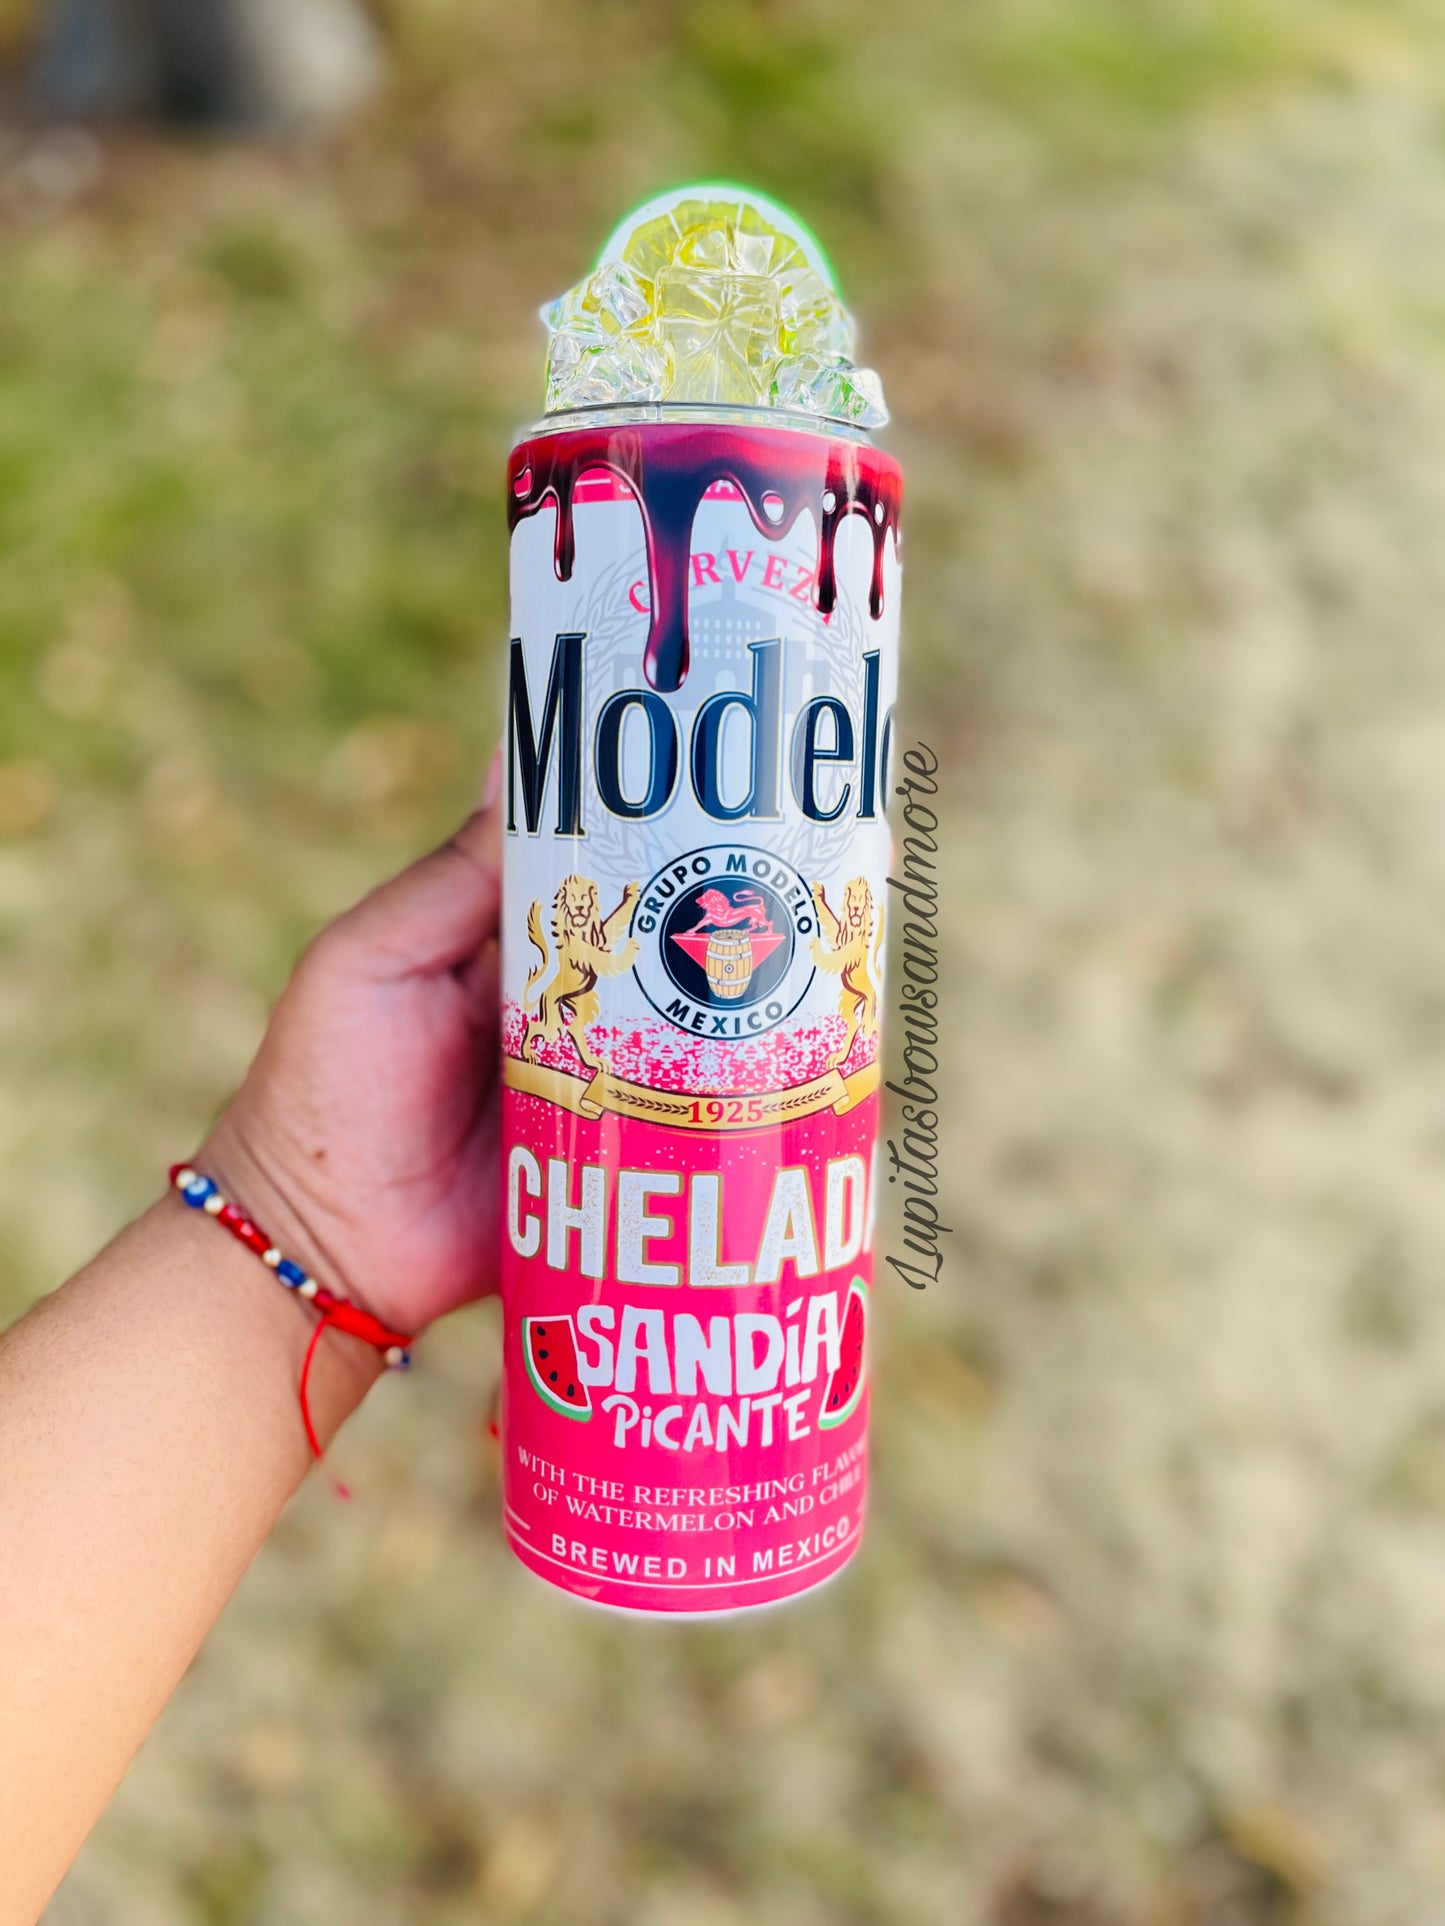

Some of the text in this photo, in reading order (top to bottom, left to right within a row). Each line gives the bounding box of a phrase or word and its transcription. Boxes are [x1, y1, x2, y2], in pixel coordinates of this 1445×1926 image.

[628, 549, 832, 627] CRVEZ
[506, 632, 894, 838] Model
[637, 853, 813, 935] GRUPO MODELO
[665, 998, 783, 1036] MEXICO
[687, 1100, 763, 1124] 1925
[518, 1445, 566, 1486] WITH
[572, 1472, 625, 1501] THE
[634, 1473, 805, 1508] REFRESHING
[533, 1482, 559, 1506] OF
[565, 1495, 754, 1532] WATERMELON
[762, 1495, 815, 1526] AND
[552, 1516, 850, 1579] BREWED IN MEXICO
